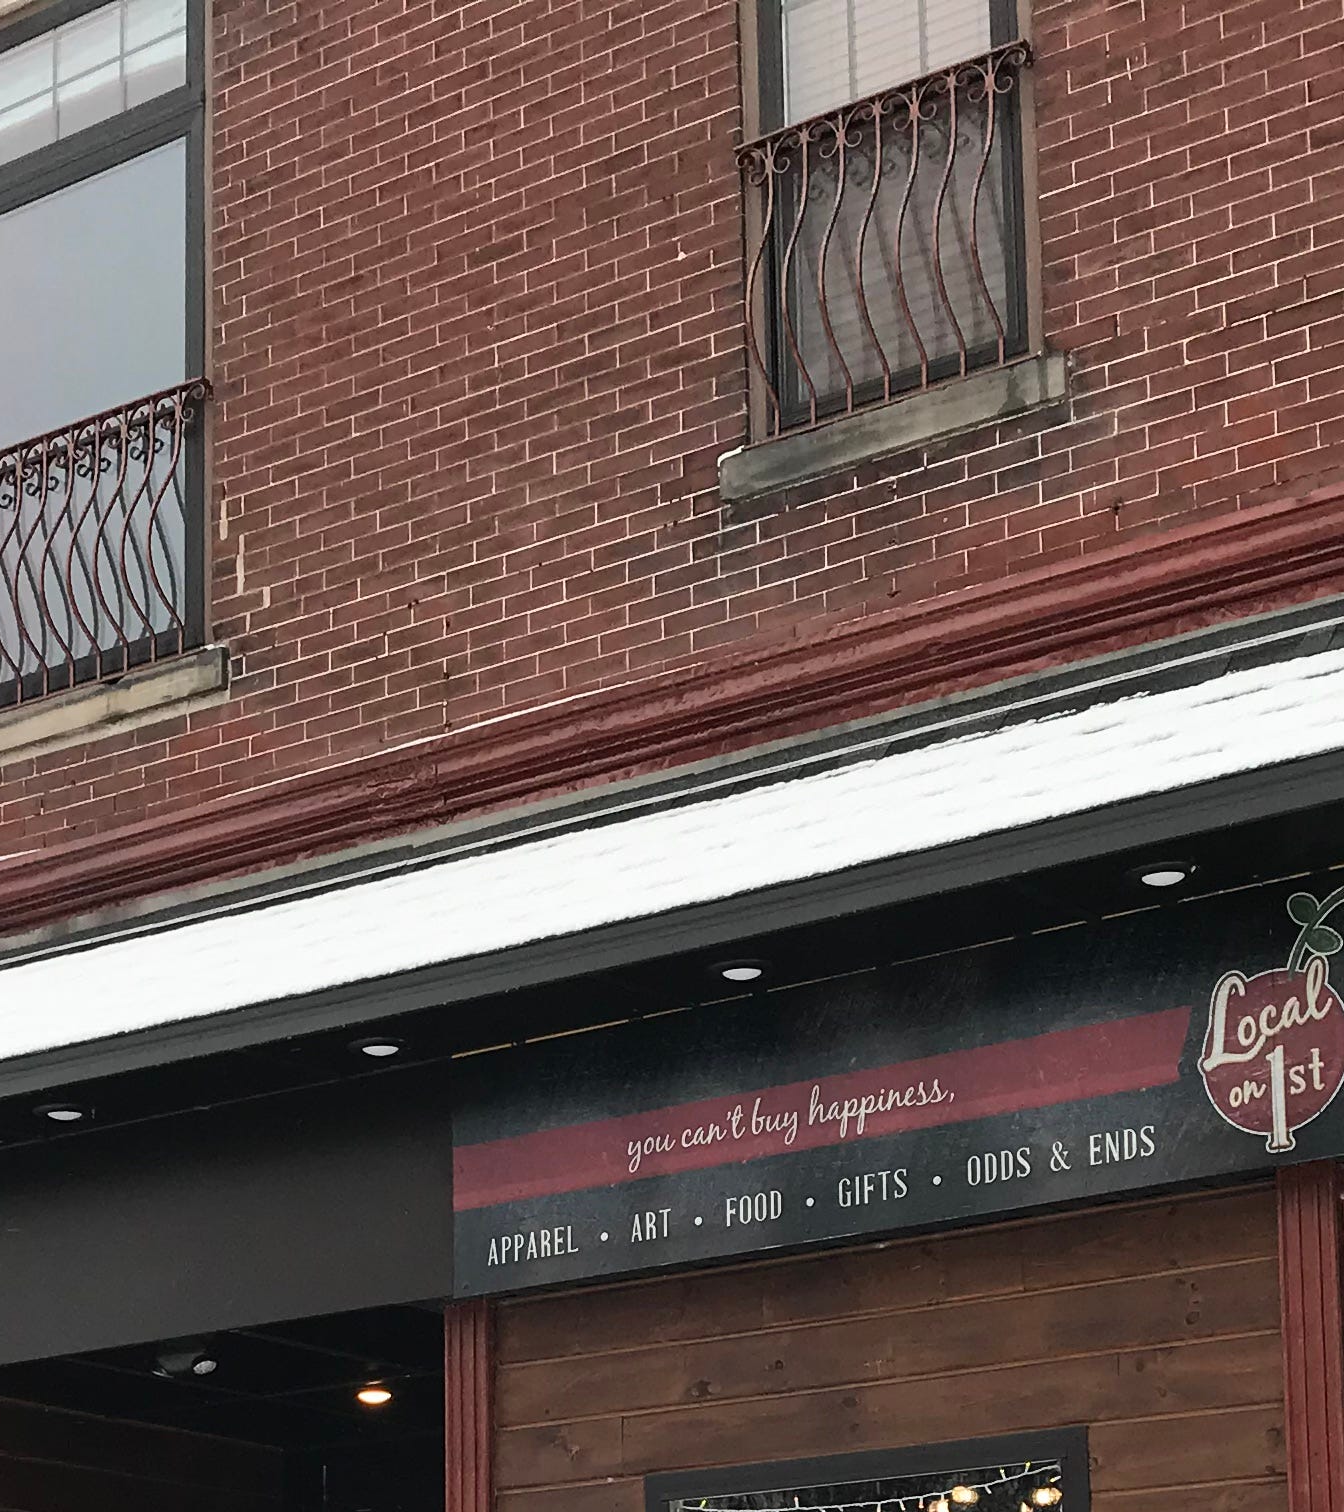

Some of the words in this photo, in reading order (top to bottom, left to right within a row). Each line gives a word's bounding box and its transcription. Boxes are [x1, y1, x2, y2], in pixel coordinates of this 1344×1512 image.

[1203, 956, 1333, 1072] Local
[627, 1135, 676, 1173] you
[681, 1103, 745, 1148] can't
[752, 1098, 799, 1145] buy
[808, 1078, 955, 1138] happiness,
[1229, 1079, 1267, 1108] on
[1265, 1045, 1326, 1149] 1st
[487, 1225, 579, 1267] APPAREL
[631, 1208, 672, 1243] ART
[726, 1190, 782, 1227] FOOD
[838, 1168, 908, 1208] GIFTS
[967, 1147, 1031, 1186] ODDS
[1049, 1140, 1072, 1172] &
[1089, 1125, 1155, 1167] ENDS
